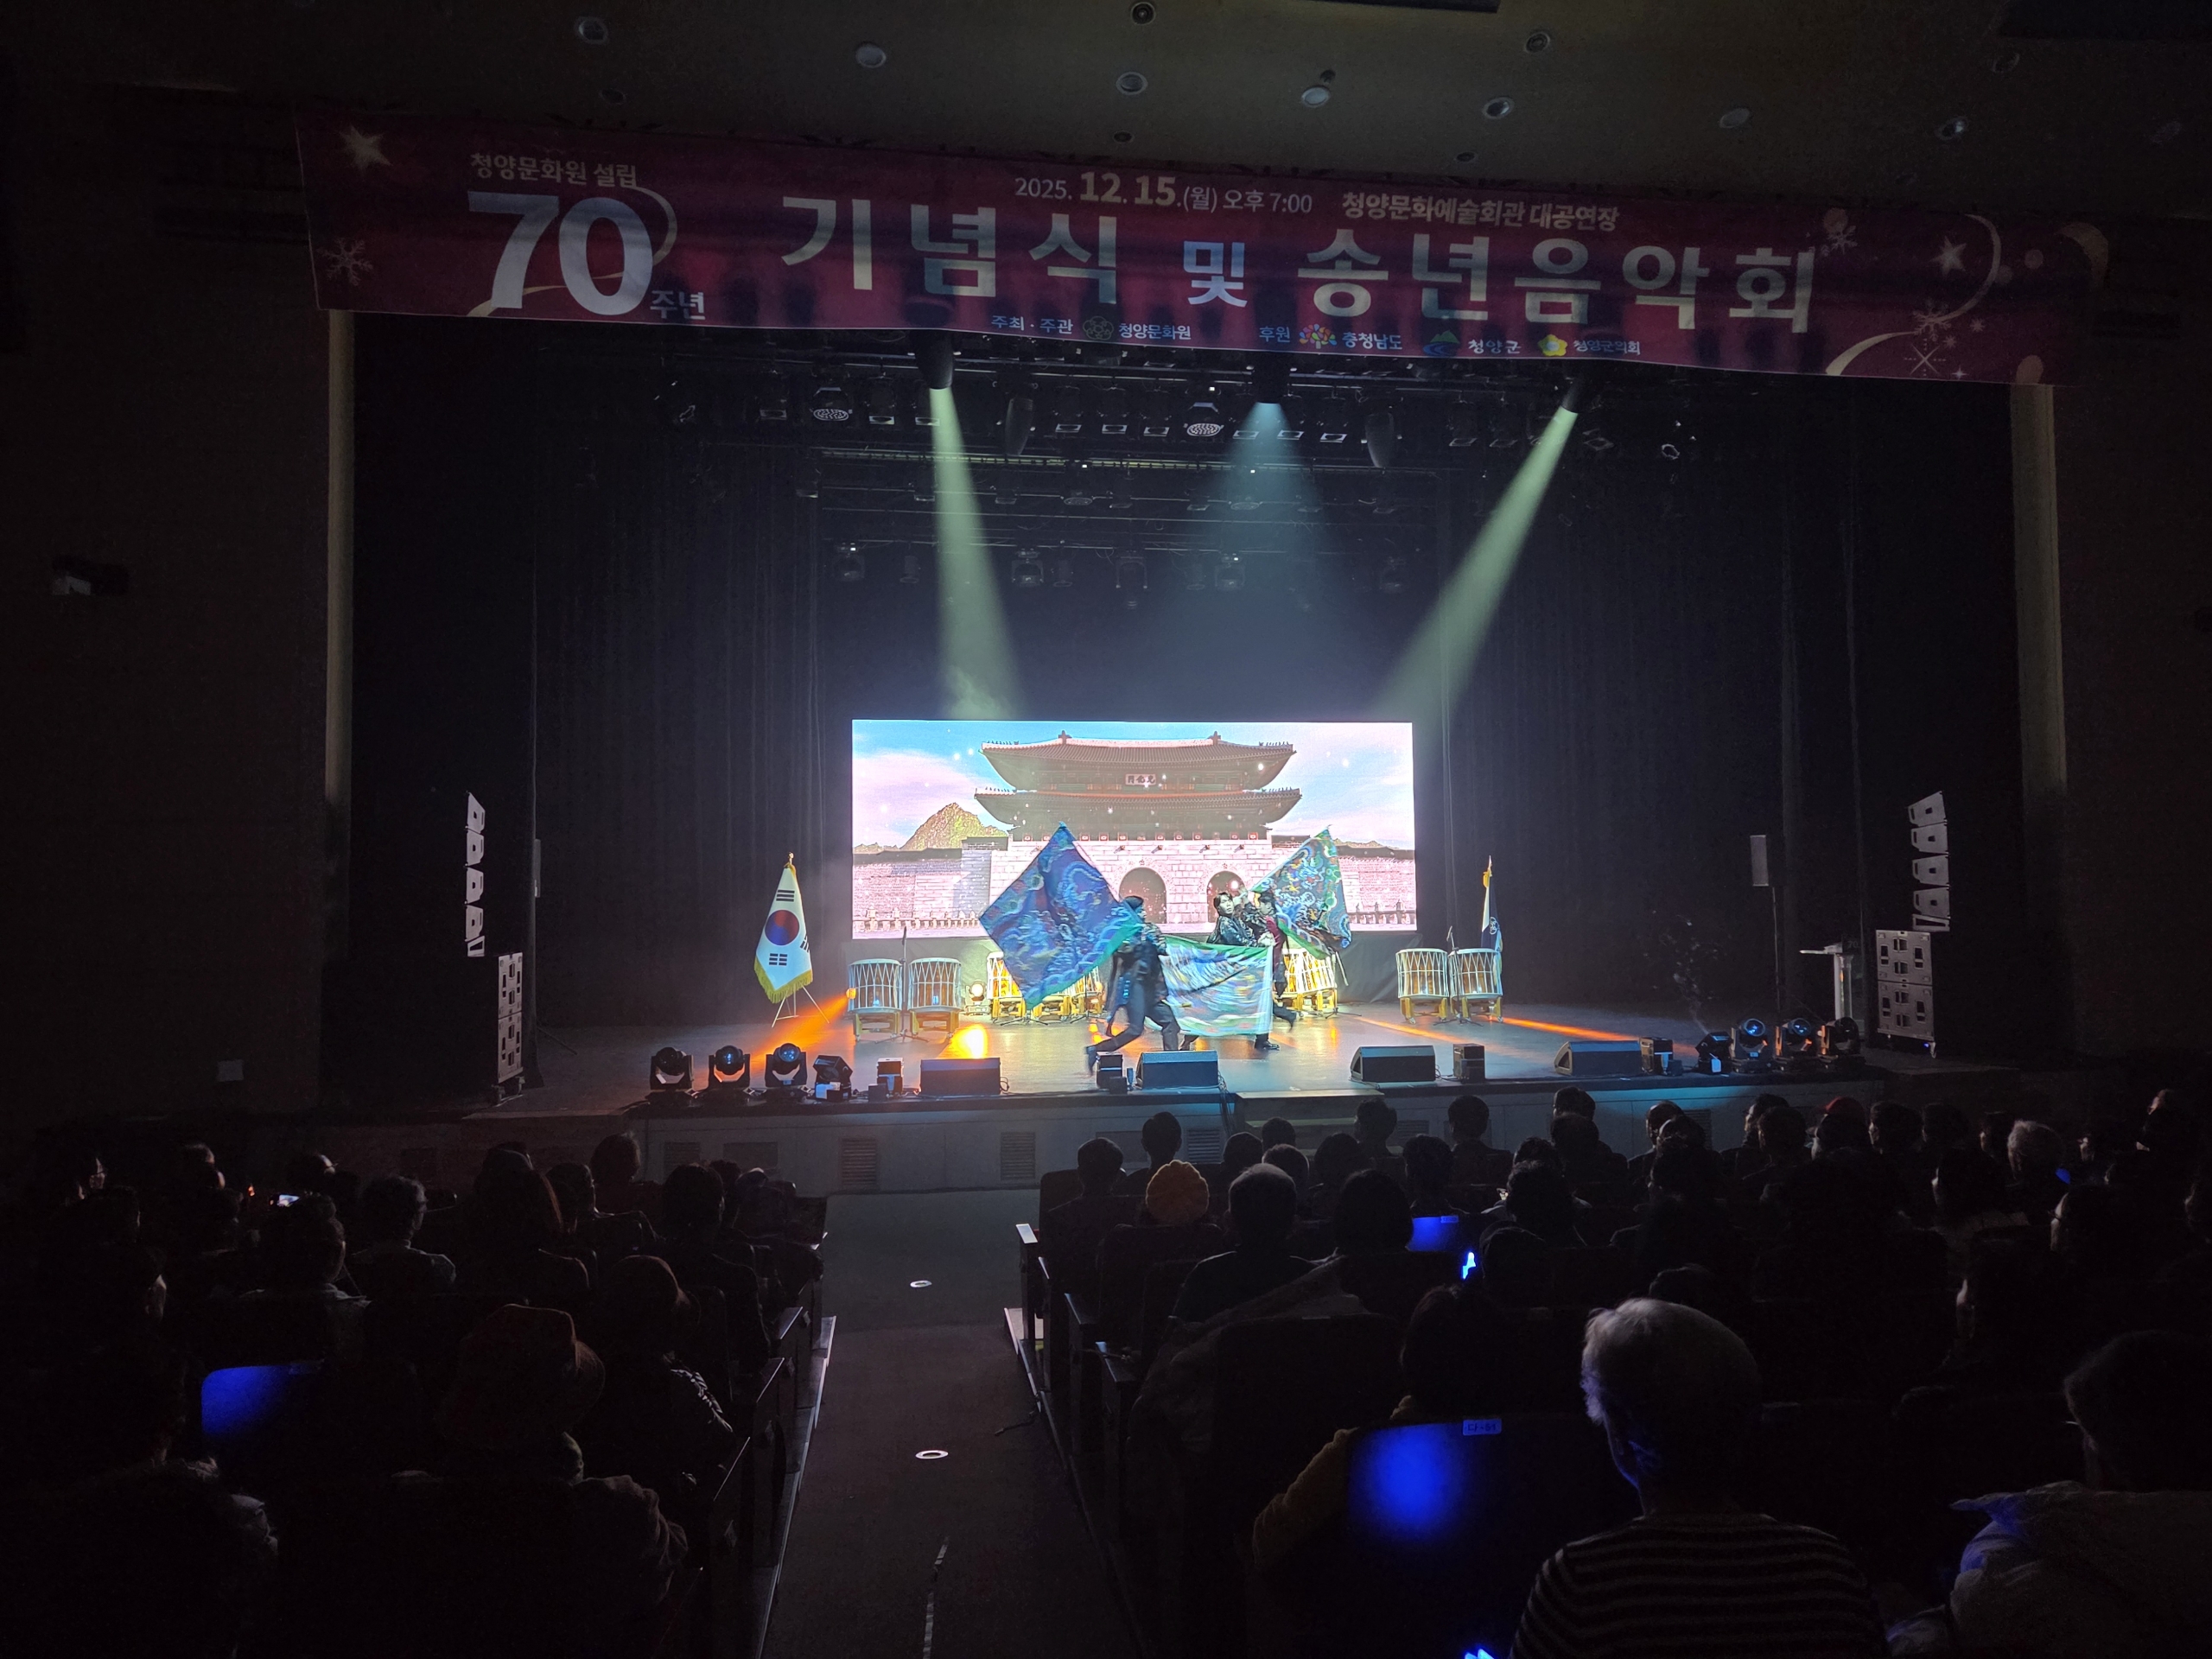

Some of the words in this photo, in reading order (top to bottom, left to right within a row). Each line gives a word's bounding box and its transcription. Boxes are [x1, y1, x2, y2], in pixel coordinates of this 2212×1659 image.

[471, 153, 587, 186] 청양문화원
[594, 162, 638, 188] 설립
[1014, 177, 1072, 200] 2025.
[1223, 188, 1264, 213] 오후
[1271, 192, 1313, 213] 7:00
[1342, 192, 1524, 226] 청양문화예술회관
[1529, 199, 1619, 232] 대공연장
[781, 196, 1117, 304] 기념식
[1183, 240, 1248, 308] 및
[991, 315, 1025, 331] 주최
[1039, 318, 1073, 335] 주관
[1118, 322, 1192, 340] 청양문화원
[1259, 326, 1291, 343] 후원
[1342, 331, 1403, 350] 충청남도
[1468, 338, 1522, 355] 청양군
[1573, 338, 1641, 356] 청양군의회
